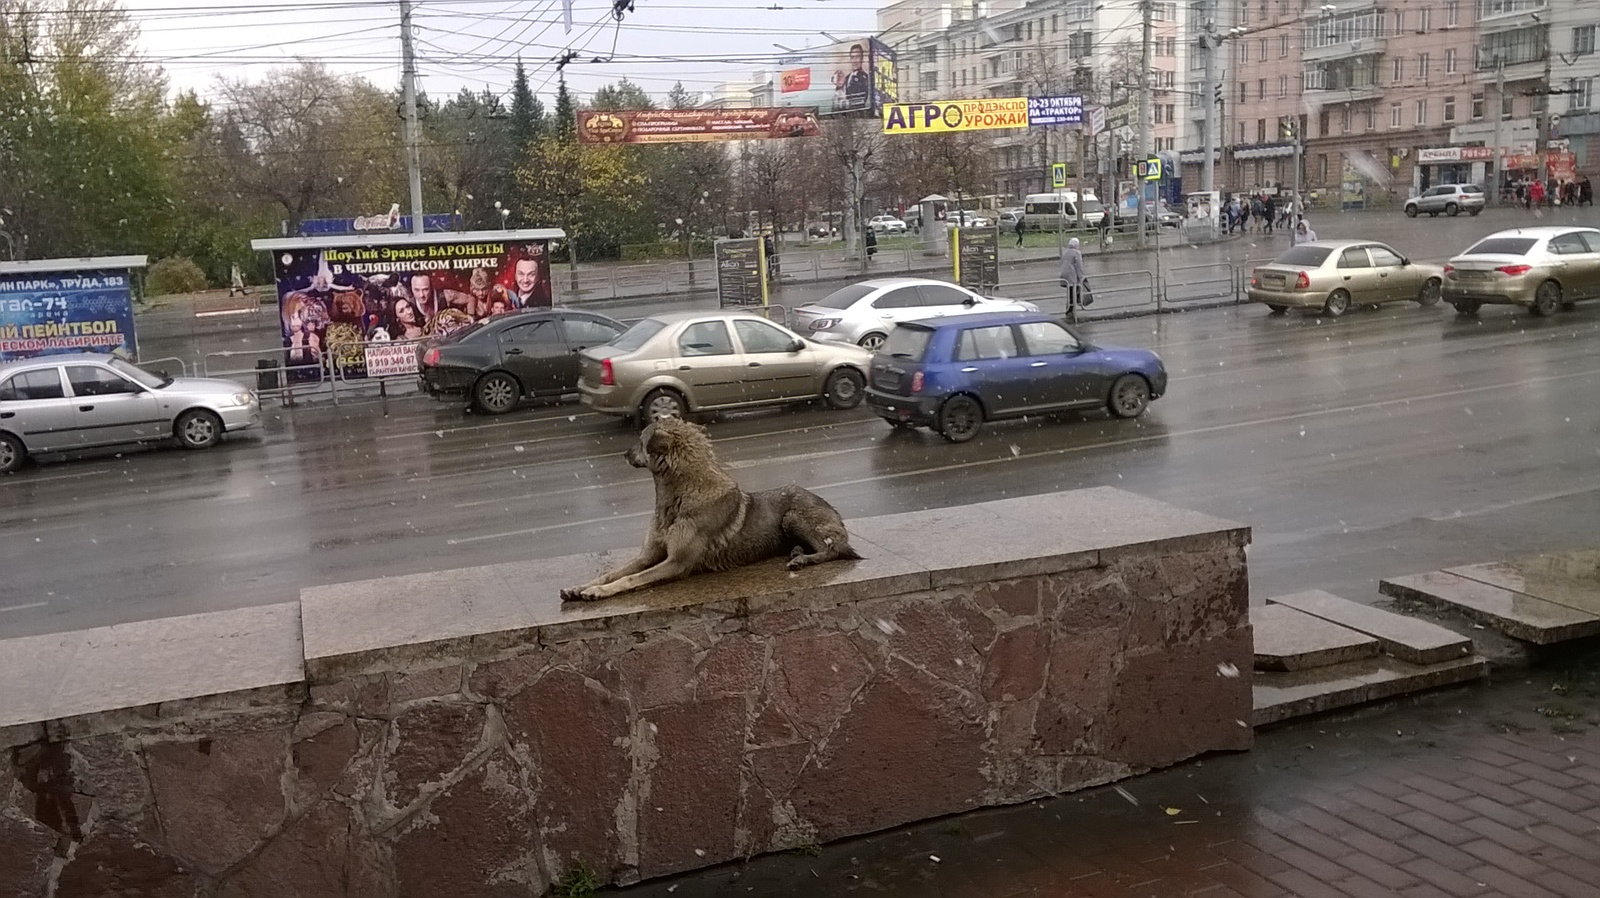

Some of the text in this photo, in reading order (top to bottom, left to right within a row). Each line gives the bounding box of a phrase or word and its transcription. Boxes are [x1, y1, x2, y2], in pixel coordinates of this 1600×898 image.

[964, 101, 1026, 113] ПРОДЭКСПО
[1029, 97, 1081, 108] 20-23 ОКТЯБРЯ
[1041, 107, 1082, 116] «ТРАКТОР»
[323, 243, 504, 263] Шоу Гий Эрадзе БАРОНЕТЫ
[333, 257, 498, 275] В ЧЕЛЯБИНСКОМ ЦИРКЕ
[103, 276, 124, 287] 183
[22, 320, 117, 338] ПЕЙНТБОЛ
[47, 335, 124, 348] ЛАБИРИНТЕ
[375, 358, 389, 367] 919
[390, 356, 405, 366] 340
